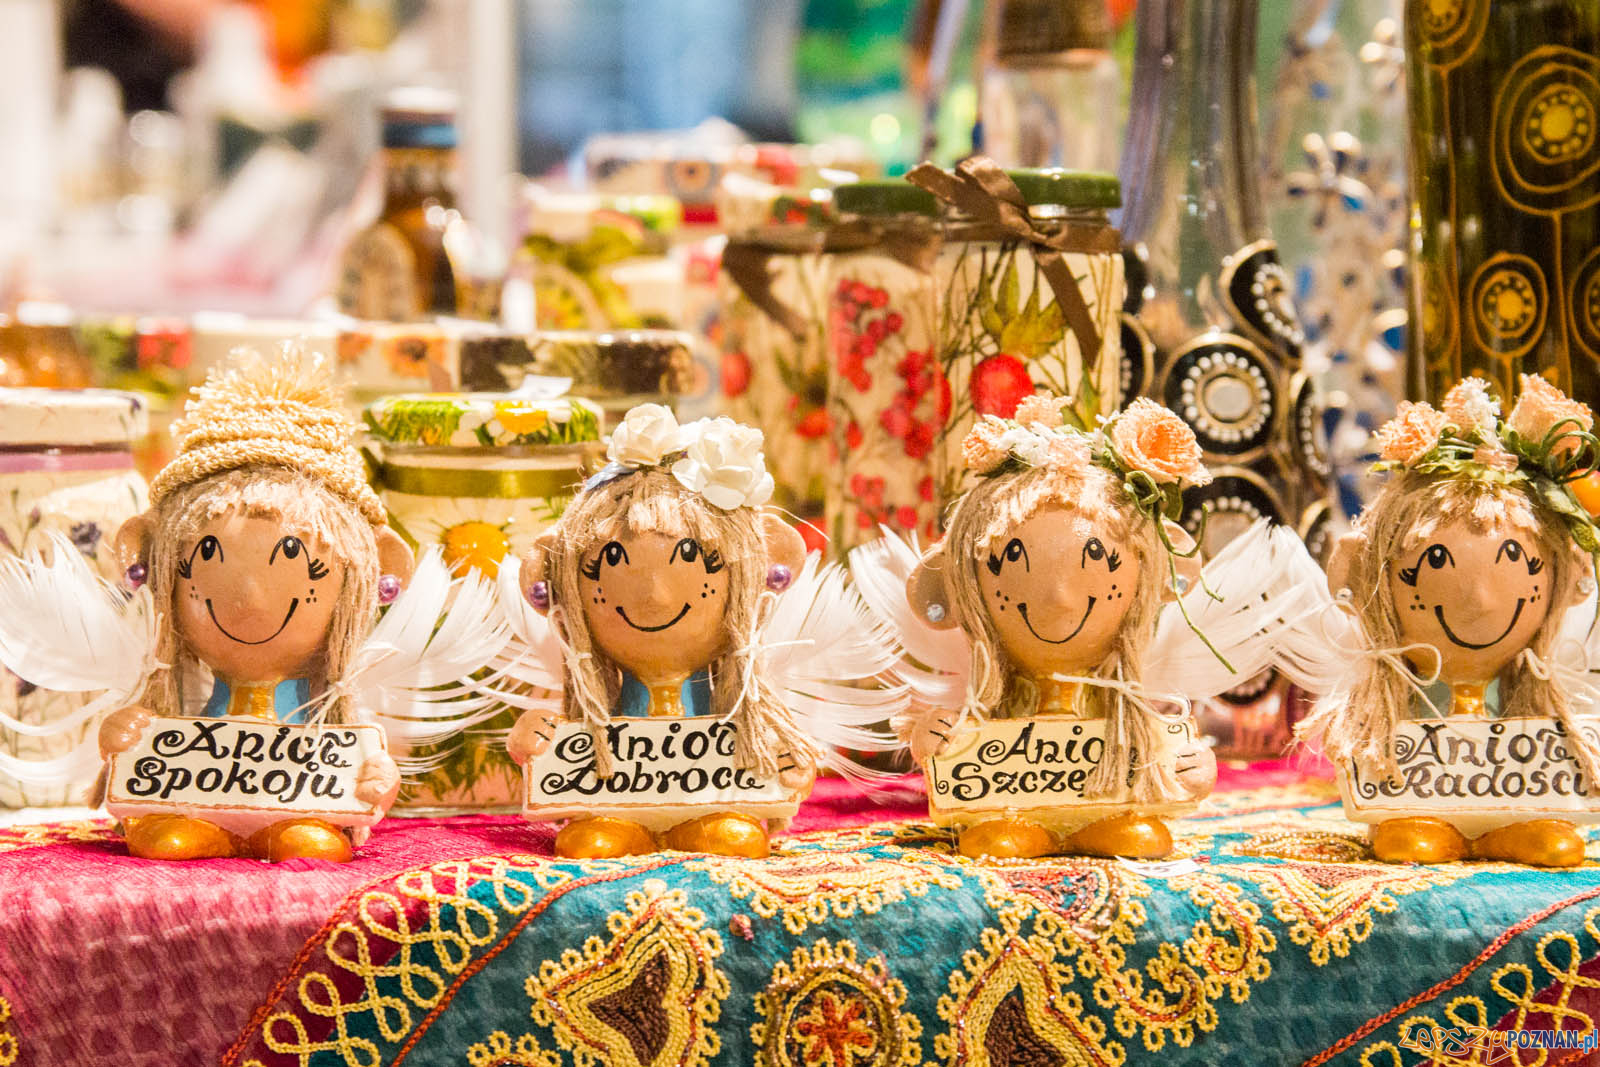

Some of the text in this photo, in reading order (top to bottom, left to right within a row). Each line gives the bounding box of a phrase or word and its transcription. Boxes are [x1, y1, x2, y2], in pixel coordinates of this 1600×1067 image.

[977, 722, 1105, 766] Anio
[126, 756, 345, 803] Spokoju
[1379, 760, 1588, 798] Radości
